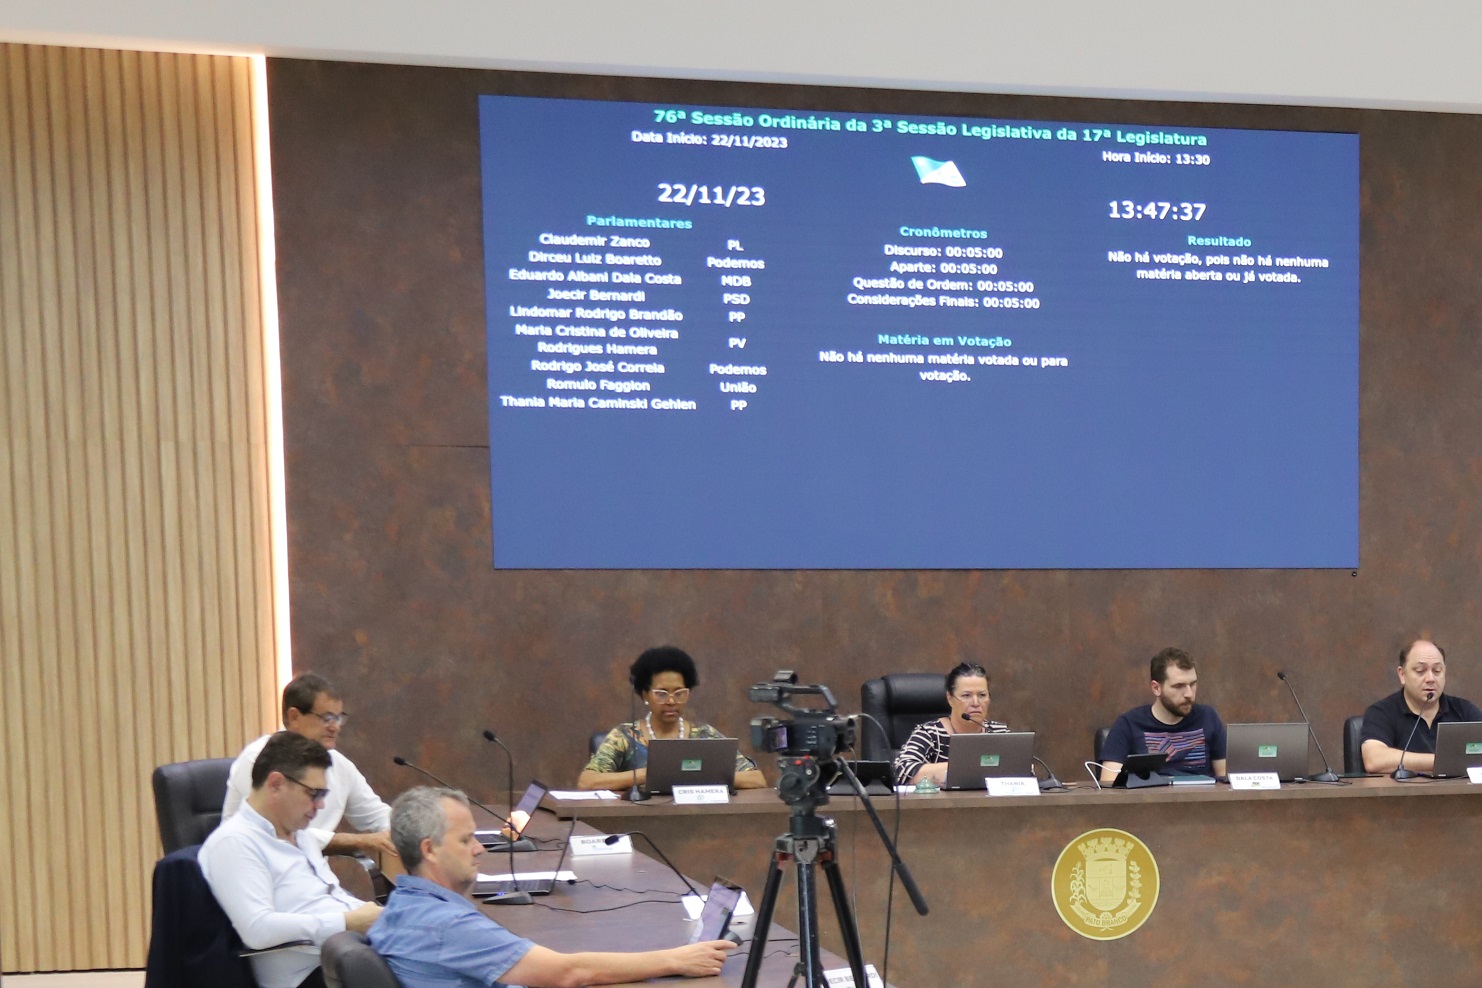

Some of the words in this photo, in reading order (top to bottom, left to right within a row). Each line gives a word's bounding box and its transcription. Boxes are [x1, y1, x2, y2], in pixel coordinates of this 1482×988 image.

[691, 111, 754, 126] Sessão
[758, 114, 840, 130] Ordinária
[845, 118, 867, 131] da
[897, 120, 957, 135] Sessão
[962, 124, 1051, 139] Legislativa
[1056, 128, 1077, 140] da
[1117, 130, 1207, 146] Legislatura
[631, 130, 663, 143] Data
[711, 134, 787, 148] 22/11/2023
[1102, 151, 1131, 162] Hora
[1176, 154, 1210, 165] 13:30
[658, 183, 765, 207] 22/11/23
[1110, 201, 1206, 220] 13:47:37
[587, 215, 692, 229] Parlamentares
[900, 226, 987, 238] Cronômetros
[539, 233, 607, 246] Claudemir
[610, 236, 650, 247] Zanco
[728, 240, 744, 251] PL
[1188, 236, 1251, 246] Resultado
[529, 251, 571, 262] Dirceu
[575, 253, 602, 264] Luiz
[606, 254, 662, 265] Boaretto
[884, 244, 941, 256] Discurso:
[946, 246, 1003, 258] 00:05:00
[707, 257, 765, 269] Podemos
[1108, 251, 1132, 262] Não
[1135, 251, 1149, 262] há
[1153, 253, 1202, 265] votação,
[1206, 255, 1230, 266] pois
[1233, 254, 1254, 265] não
[1258, 255, 1272, 266] há
[1276, 256, 1328, 267] nenhuma
[890, 261, 935, 274] Aparte:
[940, 263, 997, 274] 00:05:00
[509, 268, 564, 281] Eduardo
[567, 271, 608, 282] Albani
[612, 272, 641, 283] Dala
[644, 273, 682, 284] Costa
[721, 275, 751, 286] MDB
[1137, 268, 1181, 279] matéria
[1185, 270, 1222, 280] aberta
[1226, 272, 1240, 281] ou
[1243, 270, 1255, 283] já
[1258, 272, 1301, 282] votada.
[853, 277, 904, 290] Questão
[908, 279, 923, 289] de
[927, 279, 972, 290] Ordem:
[977, 281, 1034, 292] 00:05:00
[547, 288, 587, 299] Joecir
[590, 289, 645, 301] Bernardi
[723, 293, 750, 304] PSD
[847, 293, 936, 307] Considerações
[939, 296, 979, 307] Finais:
[983, 297, 1040, 308] 00:05:00
[510, 306, 572, 317] Lindomar
[576, 308, 625, 321] Rodrigo
[629, 309, 683, 320] Brandão
[729, 311, 745, 322] PP
[515, 324, 552, 335] Maria
[556, 325, 606, 337] Cristina
[609, 327, 626, 337] de
[629, 327, 678, 338] Oliveira
[729, 338, 746, 348] PV
[878, 334, 929, 345] Matéria
[933, 337, 954, 345] em
[958, 336, 1011, 348] Votação
[538, 342, 603, 355] Rodrigues
[606, 344, 657, 355] Hamera
[819, 350, 844, 362] Não
[847, 351, 863, 362] há
[867, 352, 924, 363] nenhuma
[928, 353, 974, 364] matéria
[978, 355, 1019, 365] votada
[1022, 357, 1037, 365] ou
[1041, 357, 1068, 368] para
[531, 360, 582, 373] Rodrigo
[585, 361, 614, 372] José
[618, 362, 665, 373] Correia
[710, 364, 767, 375] Podemos
[919, 370, 971, 383] votação.
[547, 378, 596, 390] Romulo
[600, 380, 650, 392] Faggion
[720, 381, 757, 393] União
[500, 396, 545, 407] Thania
[548, 397, 585, 408] Maria
[588, 397, 647, 409] Caminski
[651, 398, 696, 409] Gehlen
[731, 400, 747, 410] PP
[1085, 916, 1101, 926] PATO
[1101, 915, 1127, 926] BRANCO
